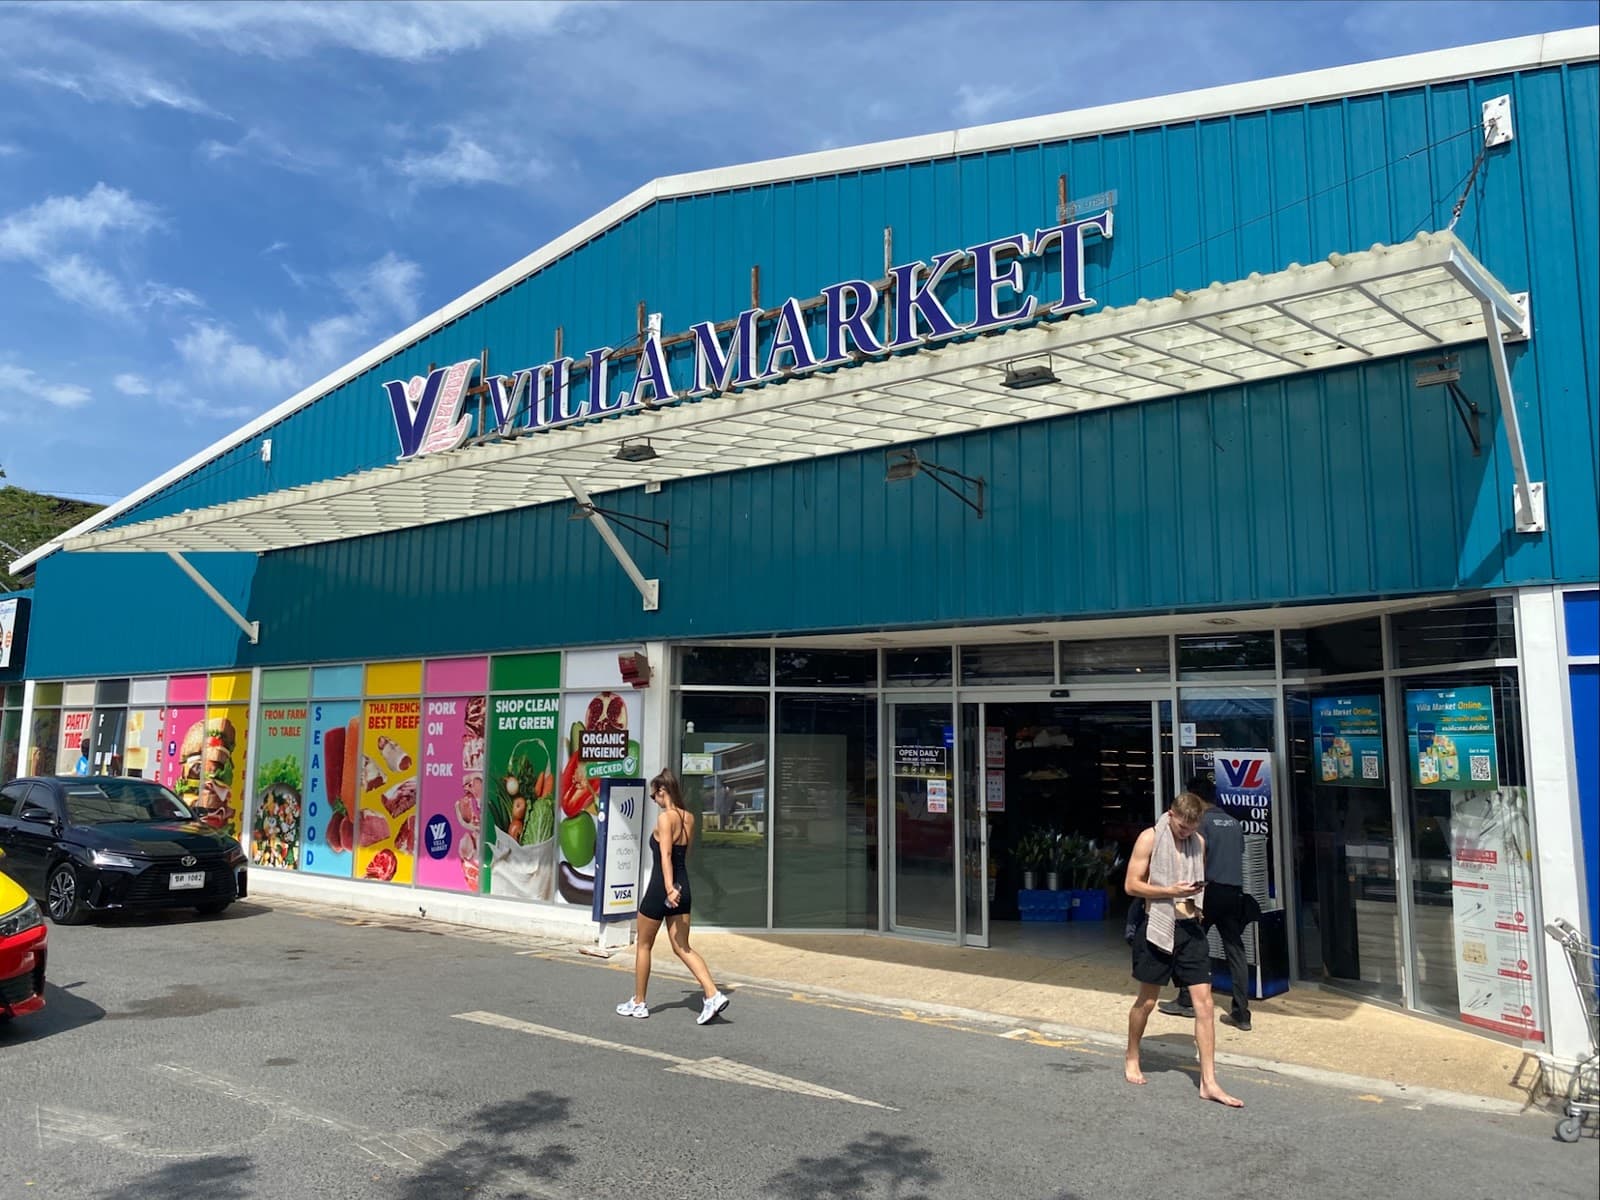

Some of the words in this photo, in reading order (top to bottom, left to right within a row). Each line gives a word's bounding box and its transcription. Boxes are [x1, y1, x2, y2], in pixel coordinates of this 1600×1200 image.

[486, 335, 678, 437] VILLA
[688, 210, 1113, 398] MARKET
[370, 703, 387, 714] THAI
[389, 702, 420, 714] FRENCH
[429, 702, 456, 715] PORK
[495, 699, 524, 713] SHOP
[525, 699, 559, 712] CLEAN
[1432, 702, 1456, 711] Market
[1457, 701, 1482, 710] Online
[65, 712, 92, 730] PARTY
[264, 710, 285, 720] FROM
[287, 709, 307, 720] FARM
[368, 716, 393, 729] BEST
[396, 715, 420, 729] BEEF
[499, 717, 518, 730] EAT
[519, 716, 554, 729] GREEN
[268, 727, 278, 737] TO
[280, 726, 301, 737] TABLE
[428, 722, 443, 736] ON
[64, 732, 83, 749] TIME
[582, 733, 625, 746] ORGANIC
[426, 743, 435, 756] A
[582, 747, 625, 759] HYGIENIC
[899, 749, 919, 757] OPEN
[919, 749, 940, 757] DAILY
[426, 763, 453, 776] FORK
[588, 763, 623, 777] CHECKED
[306, 706, 322, 865] SEAFOOD
[1220, 793, 1268, 807] WORLD
[1250, 808, 1269, 820] OF
[1240, 820, 1269, 834] ODS
[613, 889, 632, 900] VISA
